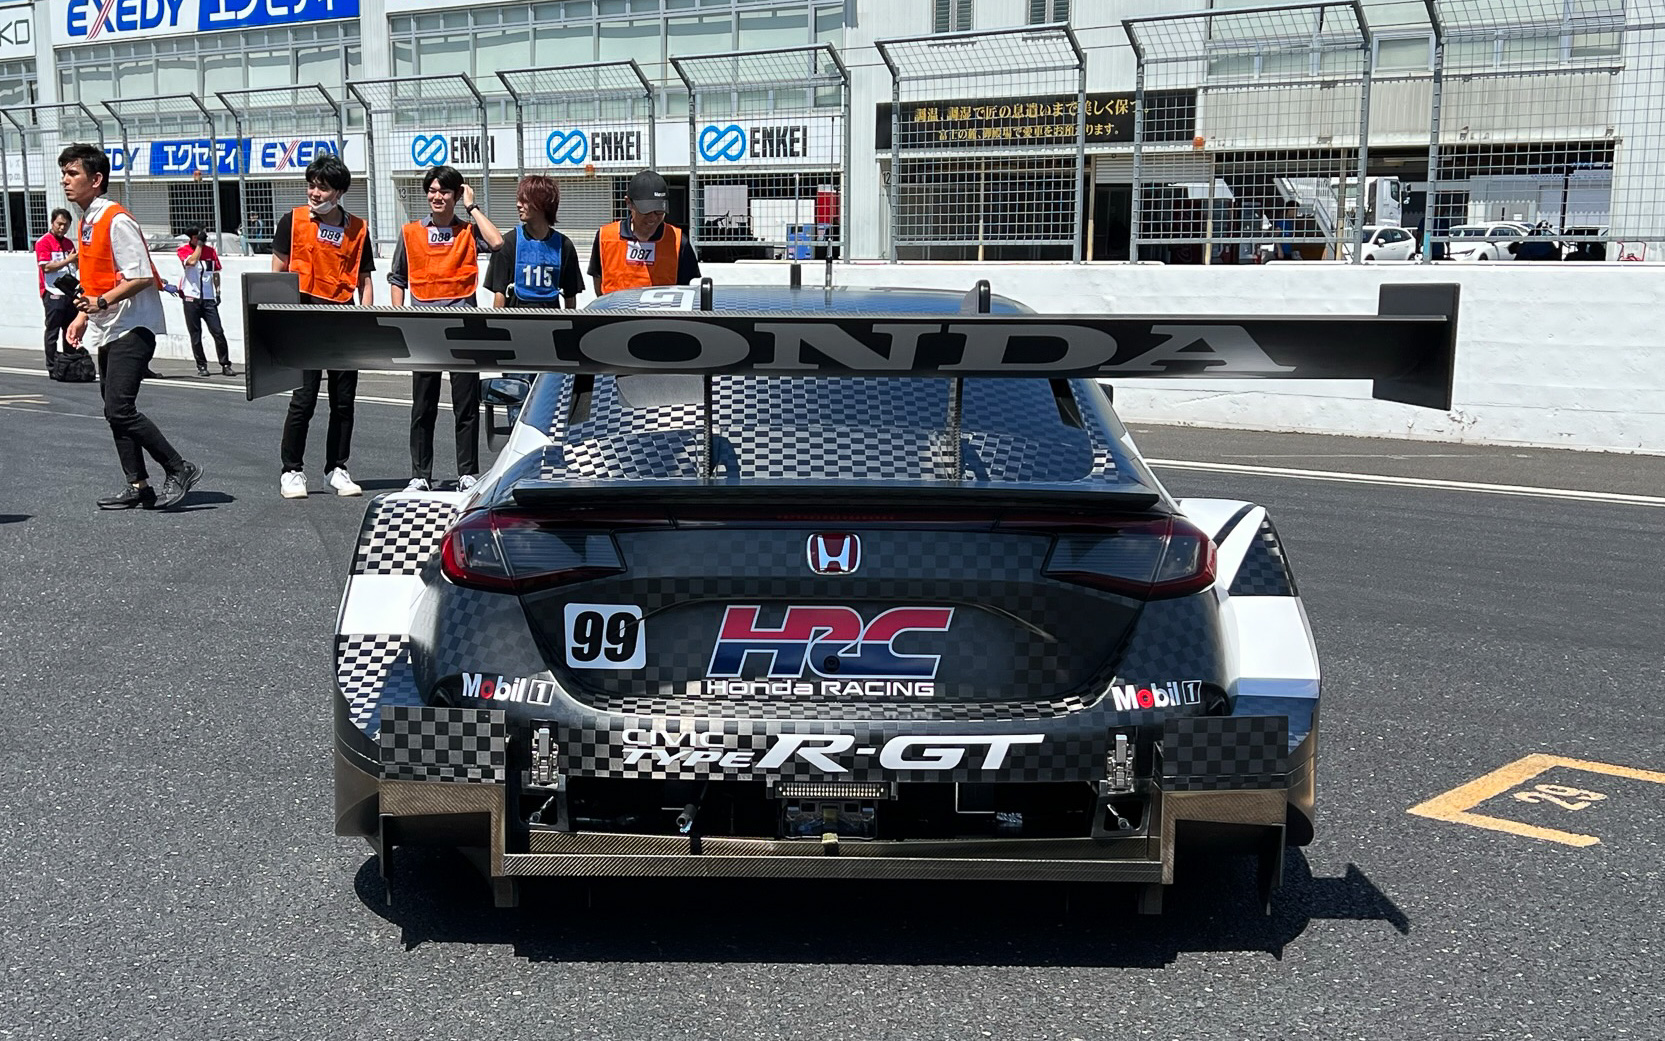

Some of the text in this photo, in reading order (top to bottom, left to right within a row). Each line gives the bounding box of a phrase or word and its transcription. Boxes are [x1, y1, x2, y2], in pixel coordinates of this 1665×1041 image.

[591, 131, 641, 161] ENKEI
[749, 125, 808, 158] ENKEI
[883, 172, 891, 184] 12
[398, 188, 407, 199] 13
[320, 228, 342, 242] 089
[430, 231, 451, 242] 088
[629, 248, 653, 260] 087
[522, 264, 554, 287] 115
[376, 317, 1297, 372] HONDA
[571, 611, 640, 662] 99
[706, 605, 955, 679] HRC
[462, 672, 528, 703] Mobil
[706, 679, 935, 697] Honda RACING
[1111, 681, 1181, 711] Mobil
[621, 728, 726, 748] CIVIC
[621, 733, 1046, 773] TYPE R-GT
